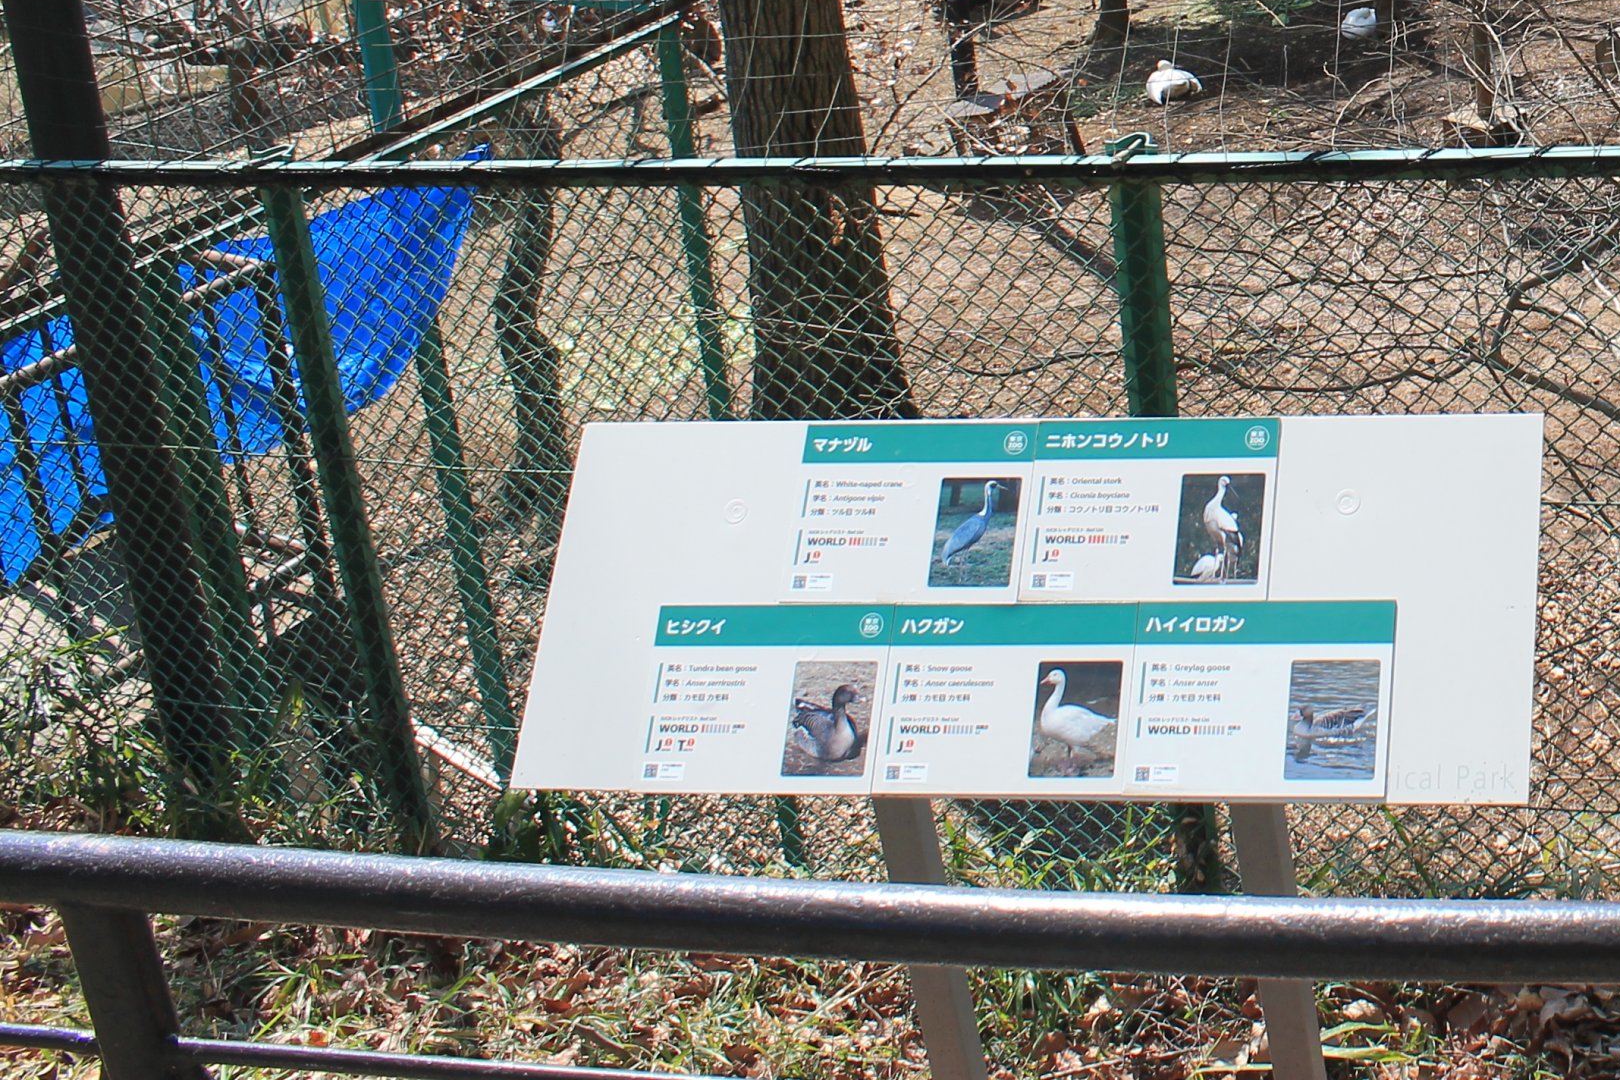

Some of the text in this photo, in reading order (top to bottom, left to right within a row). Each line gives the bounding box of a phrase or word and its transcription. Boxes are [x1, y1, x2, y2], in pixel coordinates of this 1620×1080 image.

[812, 436, 873, 453] マナヅル
[1046, 432, 1169, 448] ニホンコウノトリ
[1072, 477, 1102, 485] Oriental
[1070, 491, 1096, 499] Ciconia
[807, 537, 847, 546] WORLD
[1045, 535, 1086, 544] WORLD
[665, 618, 726, 635] ヒシクイ
[901, 617, 964, 634] ハクガン
[1145, 616, 1245, 633] ハイイロガン
[927, 664, 948, 672] Snow
[949, 665, 973, 673] goose
[1174, 663, 1205, 673] Greylag
[1206, 664, 1231, 673] goose
[924, 679, 947, 687] Anser
[1173, 679, 1196, 687] Anser
[659, 724, 699, 734] WORLD
[900, 725, 940, 735] WORLD
[1148, 725, 1191, 735] WORLD
[1457, 763, 1515, 791] Park
